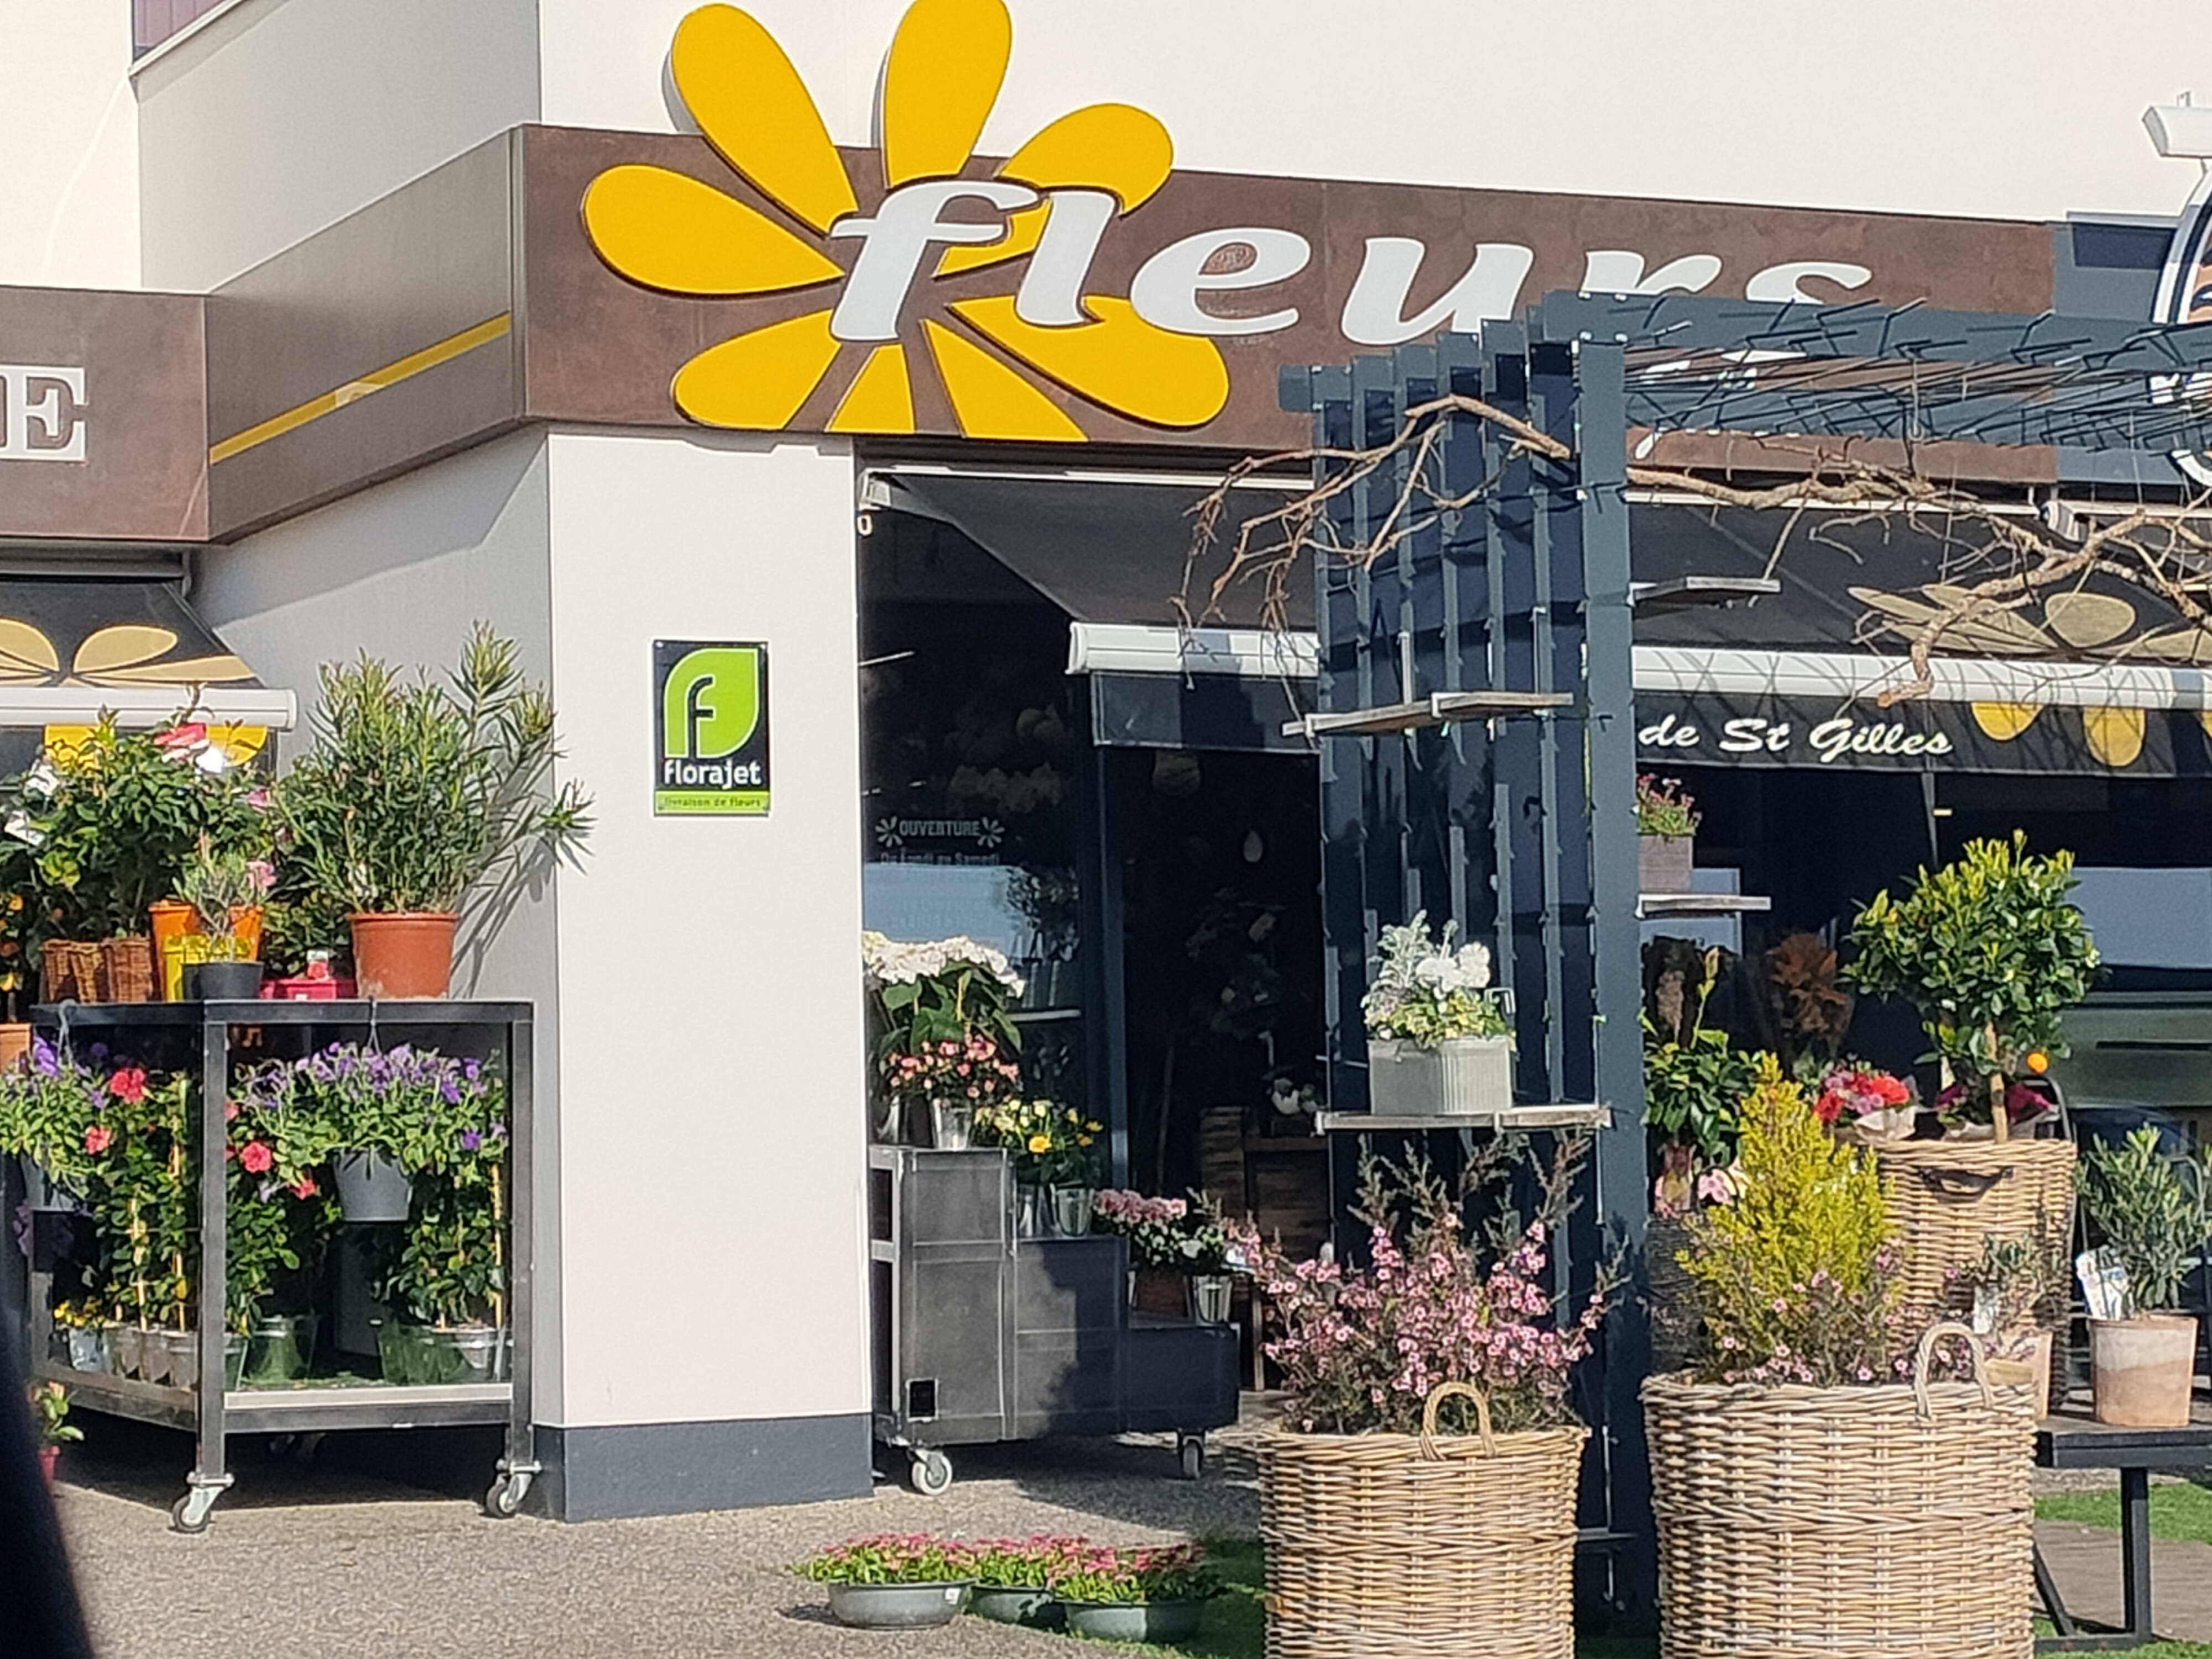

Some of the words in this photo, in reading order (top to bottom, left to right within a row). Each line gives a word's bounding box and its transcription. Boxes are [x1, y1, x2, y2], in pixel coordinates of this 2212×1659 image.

[1637, 713, 1700, 747] de
[1719, 718, 1790, 752] St
[1809, 718, 1953, 763] Gilles
[664, 759, 761, 790] florajet
[665, 797, 710, 807] livraison
[714, 797, 727, 807] de
[730, 797, 761, 807] fleurs
[899, 820, 980, 836] OUVERTURE
